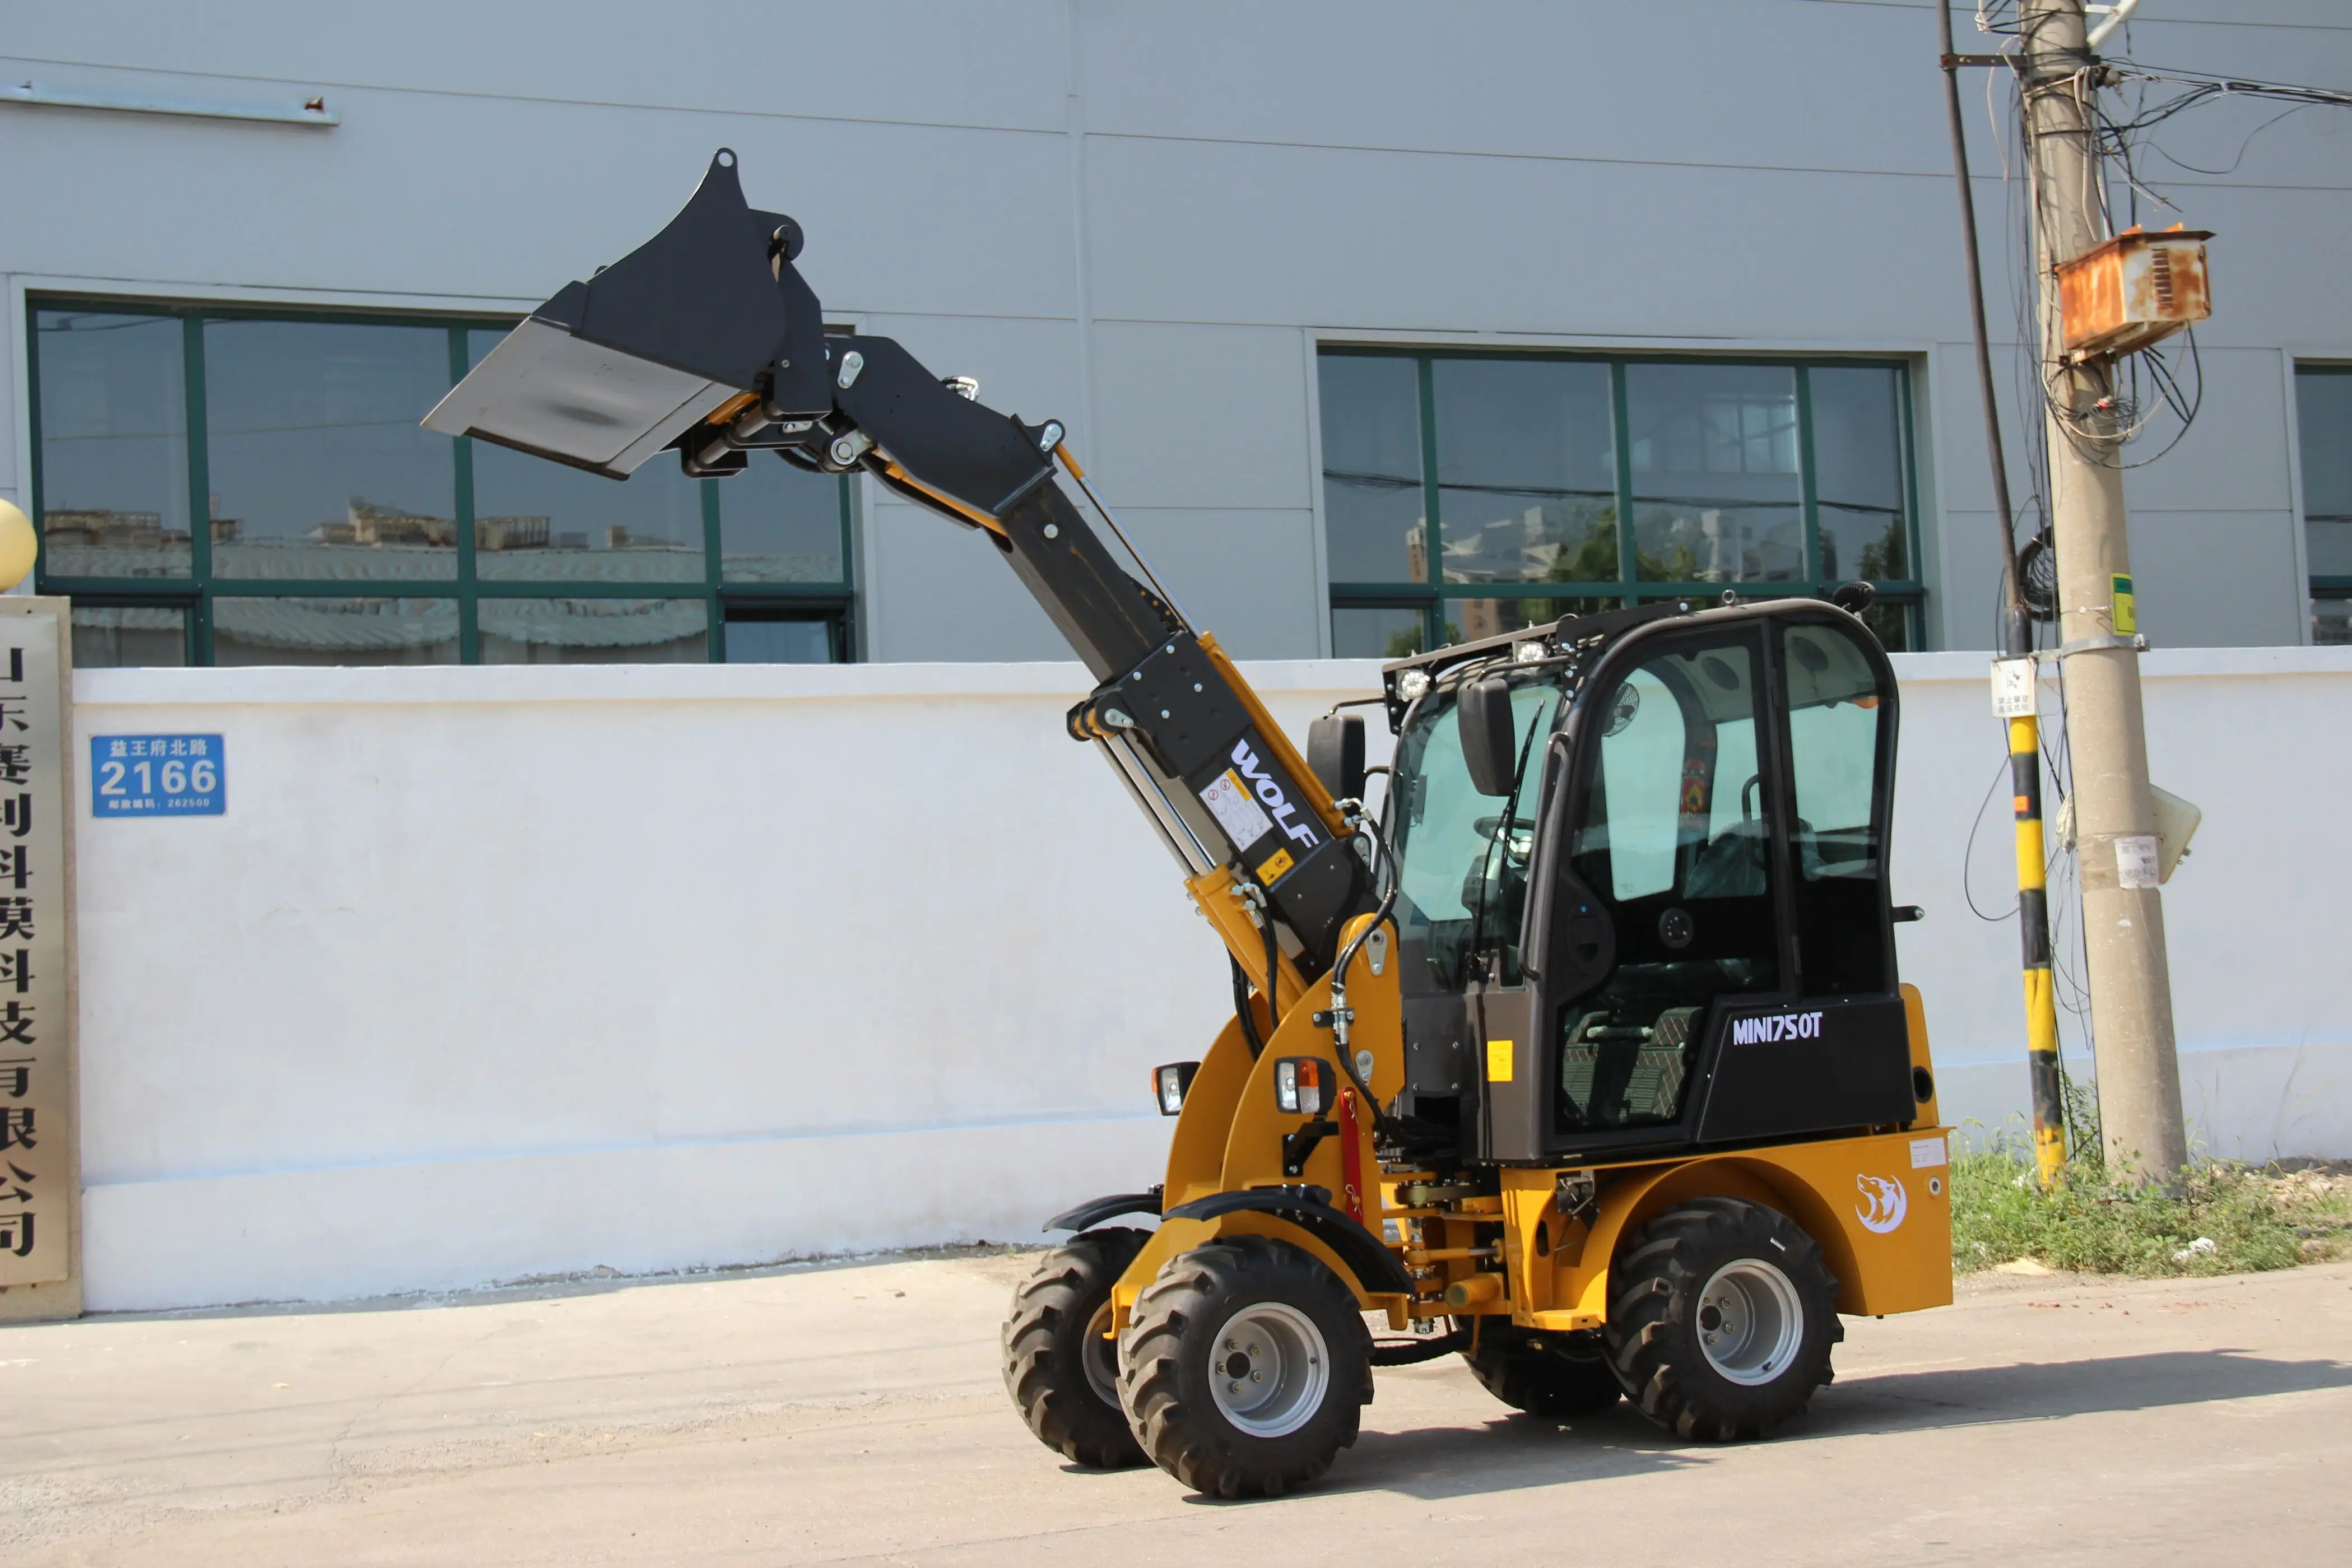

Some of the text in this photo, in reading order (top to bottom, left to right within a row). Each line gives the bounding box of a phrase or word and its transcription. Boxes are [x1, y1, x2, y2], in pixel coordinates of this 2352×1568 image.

[110, 739, 207, 757] 益王府北路
[100, 760, 216, 795] 2166
[168, 798, 210, 807] 262500
[1231, 738, 1319, 848] WOLF
